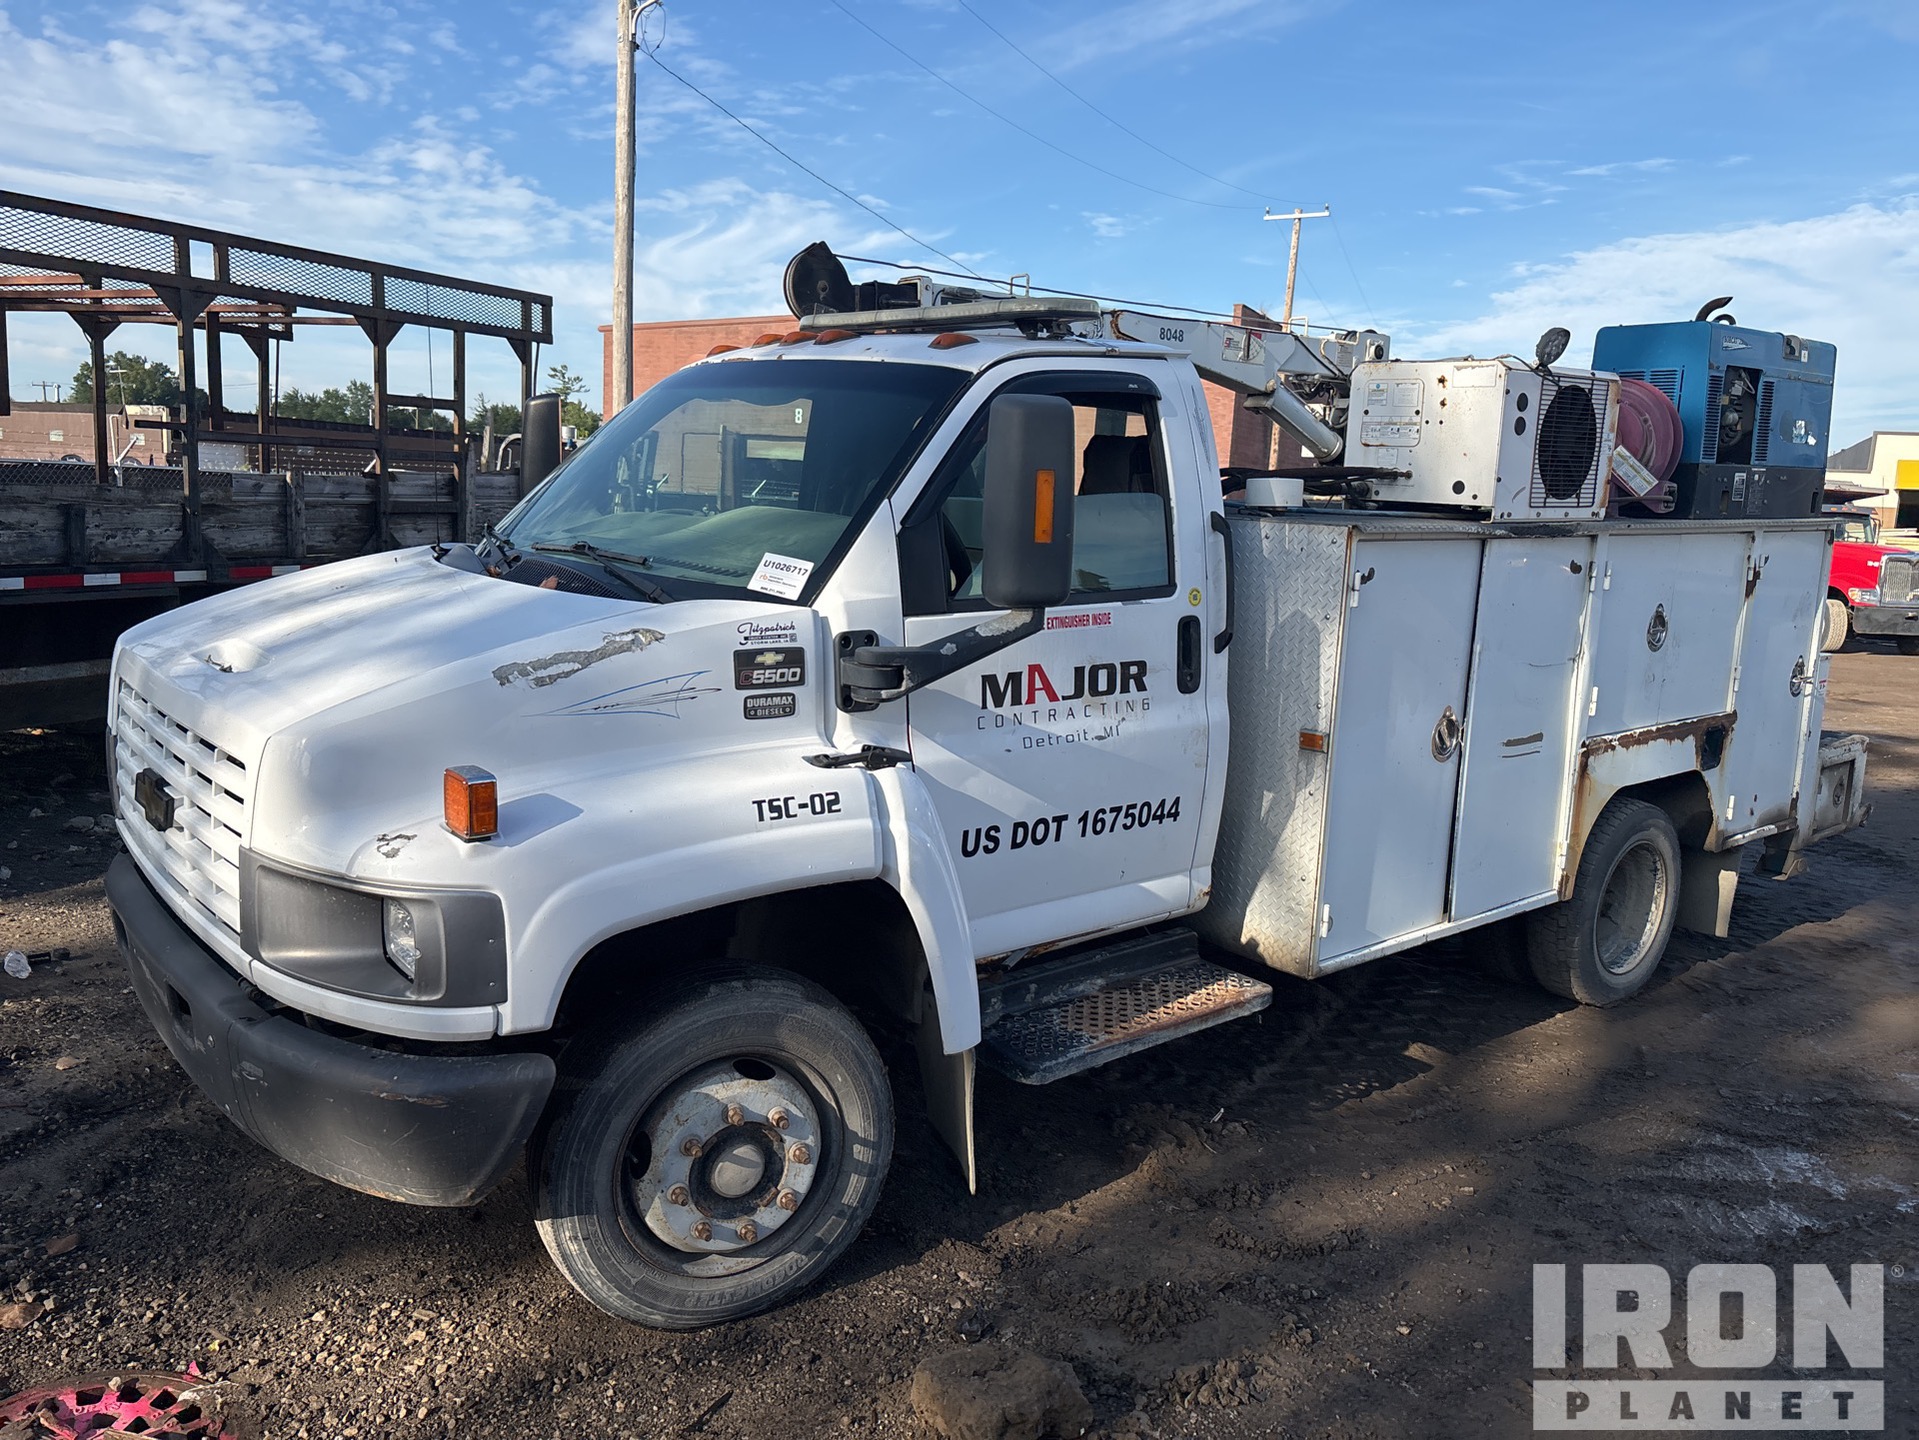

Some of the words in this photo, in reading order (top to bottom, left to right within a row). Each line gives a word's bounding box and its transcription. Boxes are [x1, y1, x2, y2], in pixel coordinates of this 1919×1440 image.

[1159, 327, 1184, 342] 8048
[795, 408, 803, 424] 8
[763, 559, 809, 576] U1026717
[1046, 614, 1091, 630] EXTINGUISHER
[1091, 612, 1112, 626] INSIDE
[740, 667, 801, 685] C5500
[980, 660, 1148, 710] MAJOR
[747, 696, 793, 708] DURAMAX
[756, 707, 784, 716] DIESEL
[977, 697, 1151, 730] CONTRACTING
[752, 791, 842, 822] TSC-02
[961, 825, 1002, 858] US
[1010, 814, 1069, 850] DOT
[1077, 796, 1181, 838] 1675044
